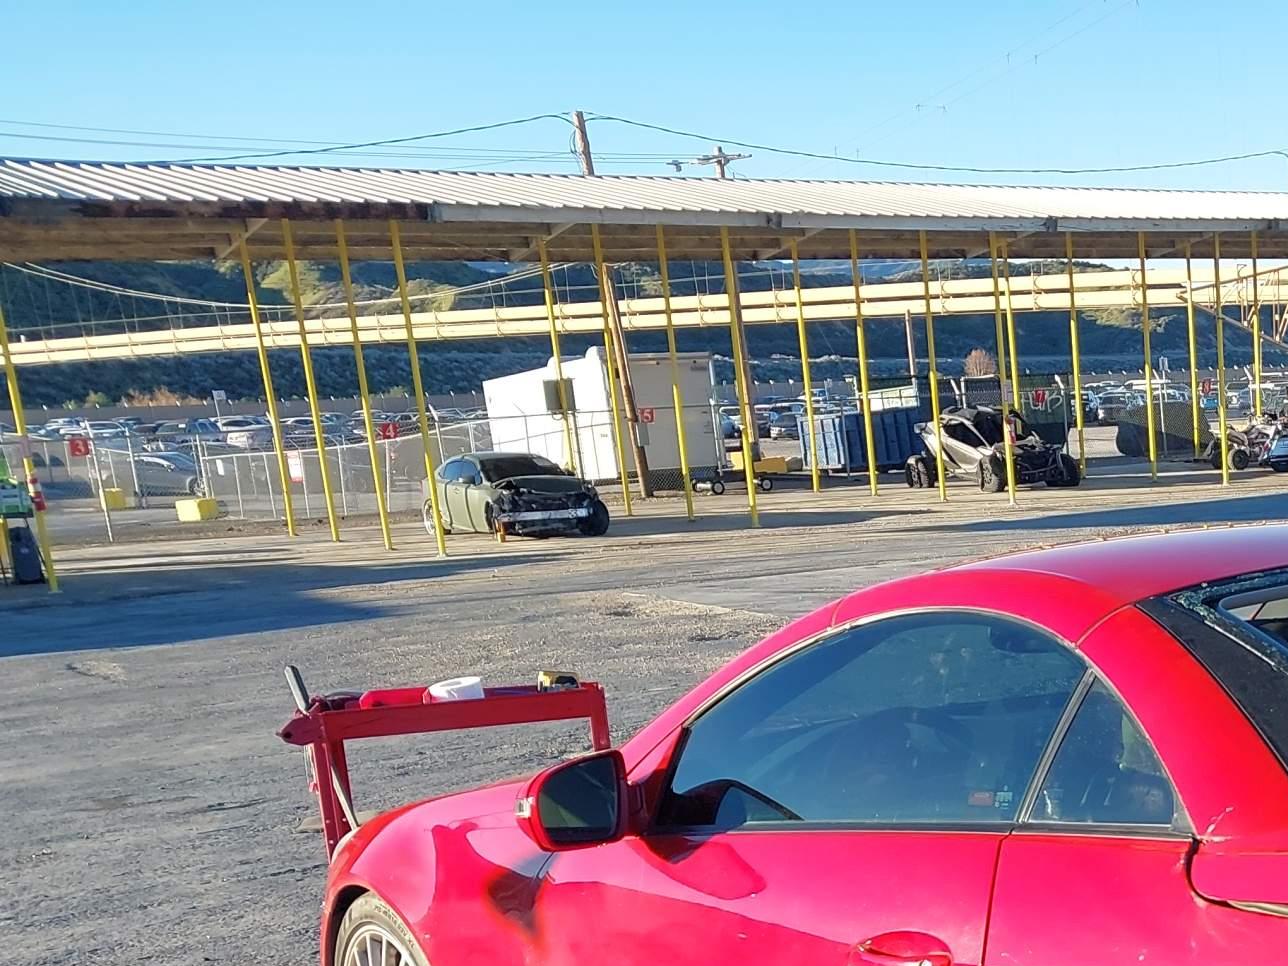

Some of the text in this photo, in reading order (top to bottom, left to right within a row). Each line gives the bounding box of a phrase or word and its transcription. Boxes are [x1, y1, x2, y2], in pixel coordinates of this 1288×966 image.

[643, 410, 651, 422] 5
[385, 424, 394, 438] 4
[75, 440, 85, 455] 3
